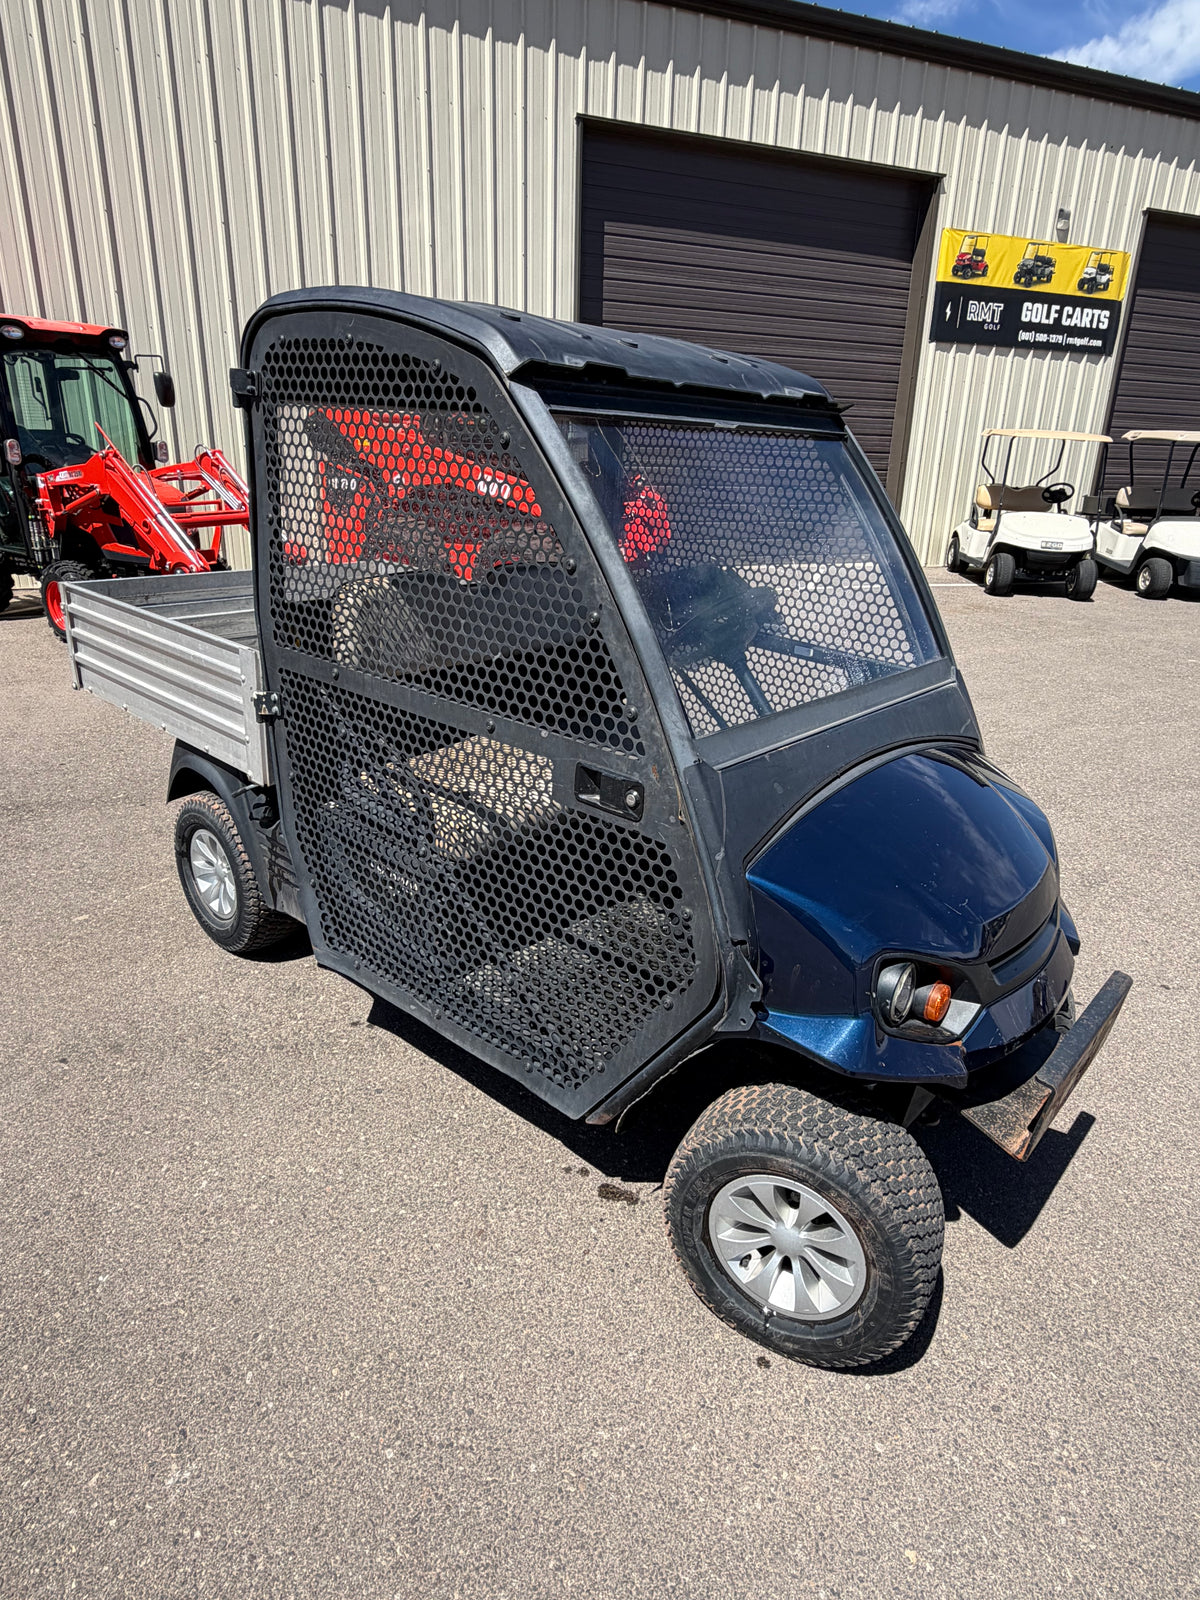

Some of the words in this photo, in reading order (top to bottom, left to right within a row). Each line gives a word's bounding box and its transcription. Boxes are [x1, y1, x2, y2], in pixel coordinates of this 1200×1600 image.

[966, 300, 1004, 323] RMT
[1021, 301, 1060, 325] GOLF
[1061, 305, 1111, 330] CARTS
[983, 323, 1001, 331] GOLF
[1018, 329, 1035, 343] (801)
[1066, 336, 1103, 347] rmtgolf.com
